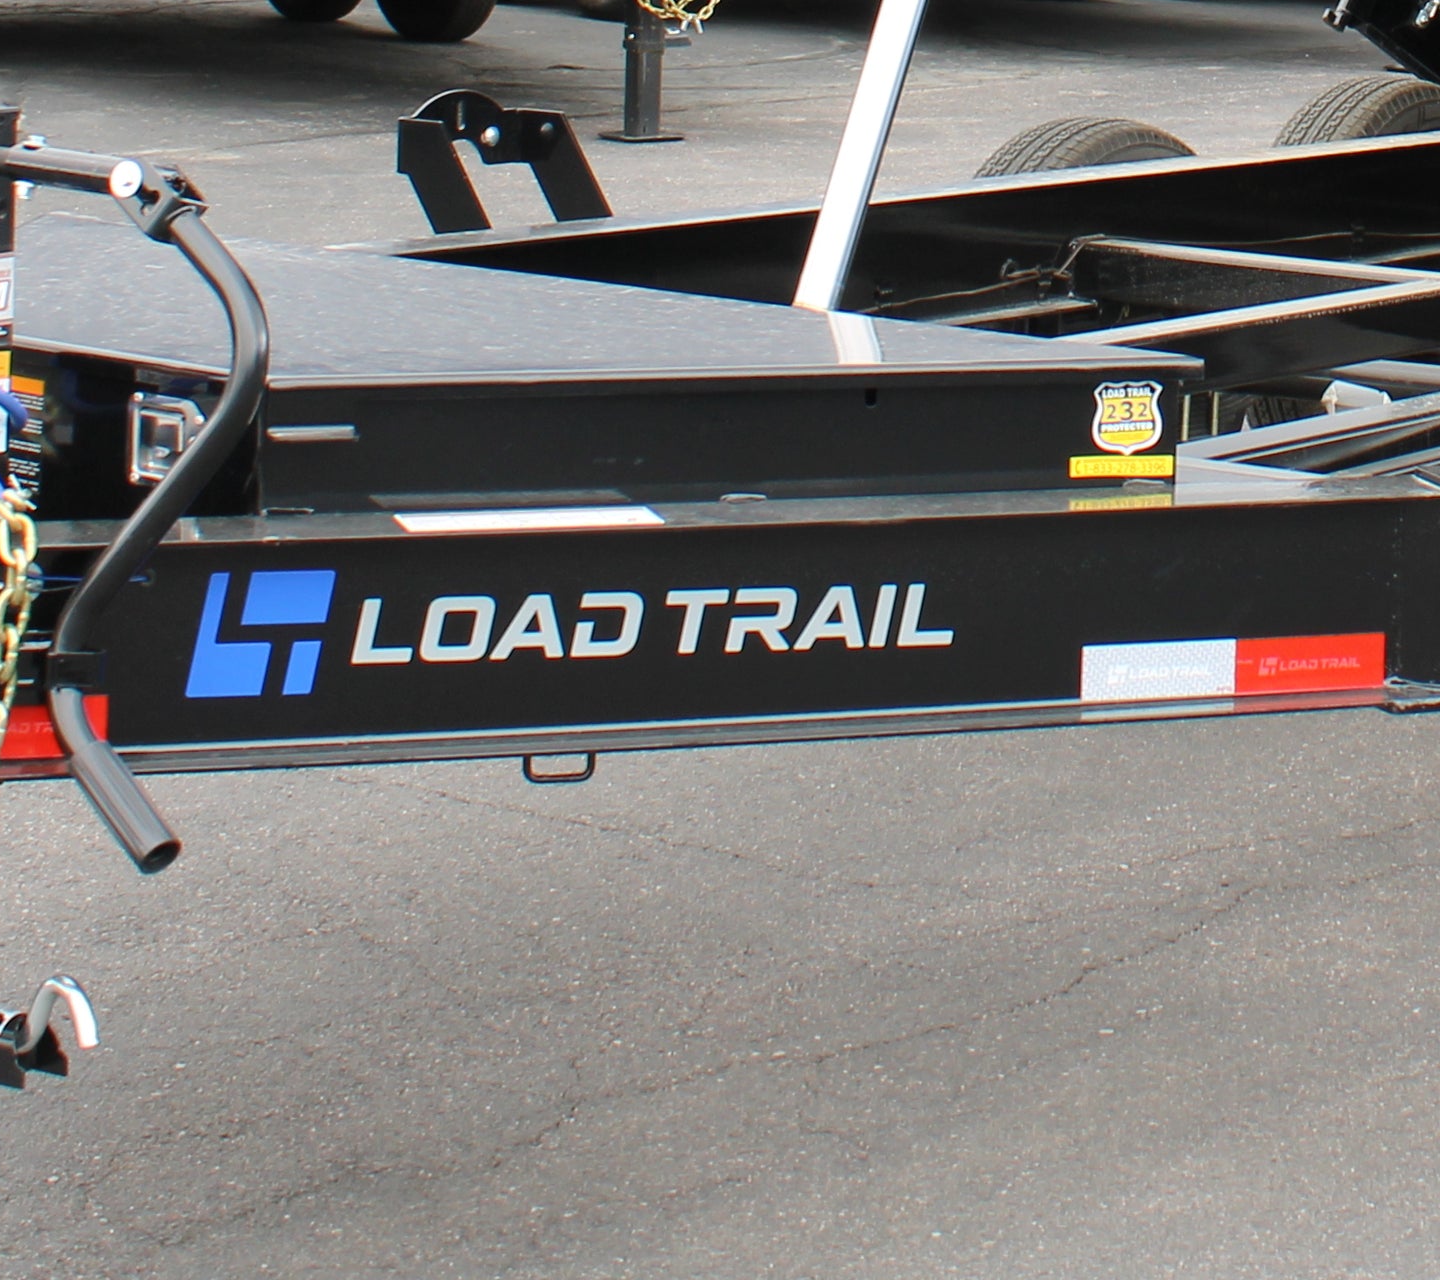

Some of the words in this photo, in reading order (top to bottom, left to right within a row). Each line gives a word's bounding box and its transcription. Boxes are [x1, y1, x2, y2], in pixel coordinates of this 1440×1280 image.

[1101, 388, 1126, 398] LOAD
[1126, 386, 1152, 398] TRAIL
[1106, 400, 1148, 420] 232
[1101, 422, 1154, 433] PROTECTED
[1083, 462, 1167, 474] 1-833-278-3396
[350, 589, 646, 665] LOAD
[665, 582, 955, 656] TRAIL
[1278, 659, 1321, 671] LOAD
[1321, 656, 1361, 669] TRAIL
